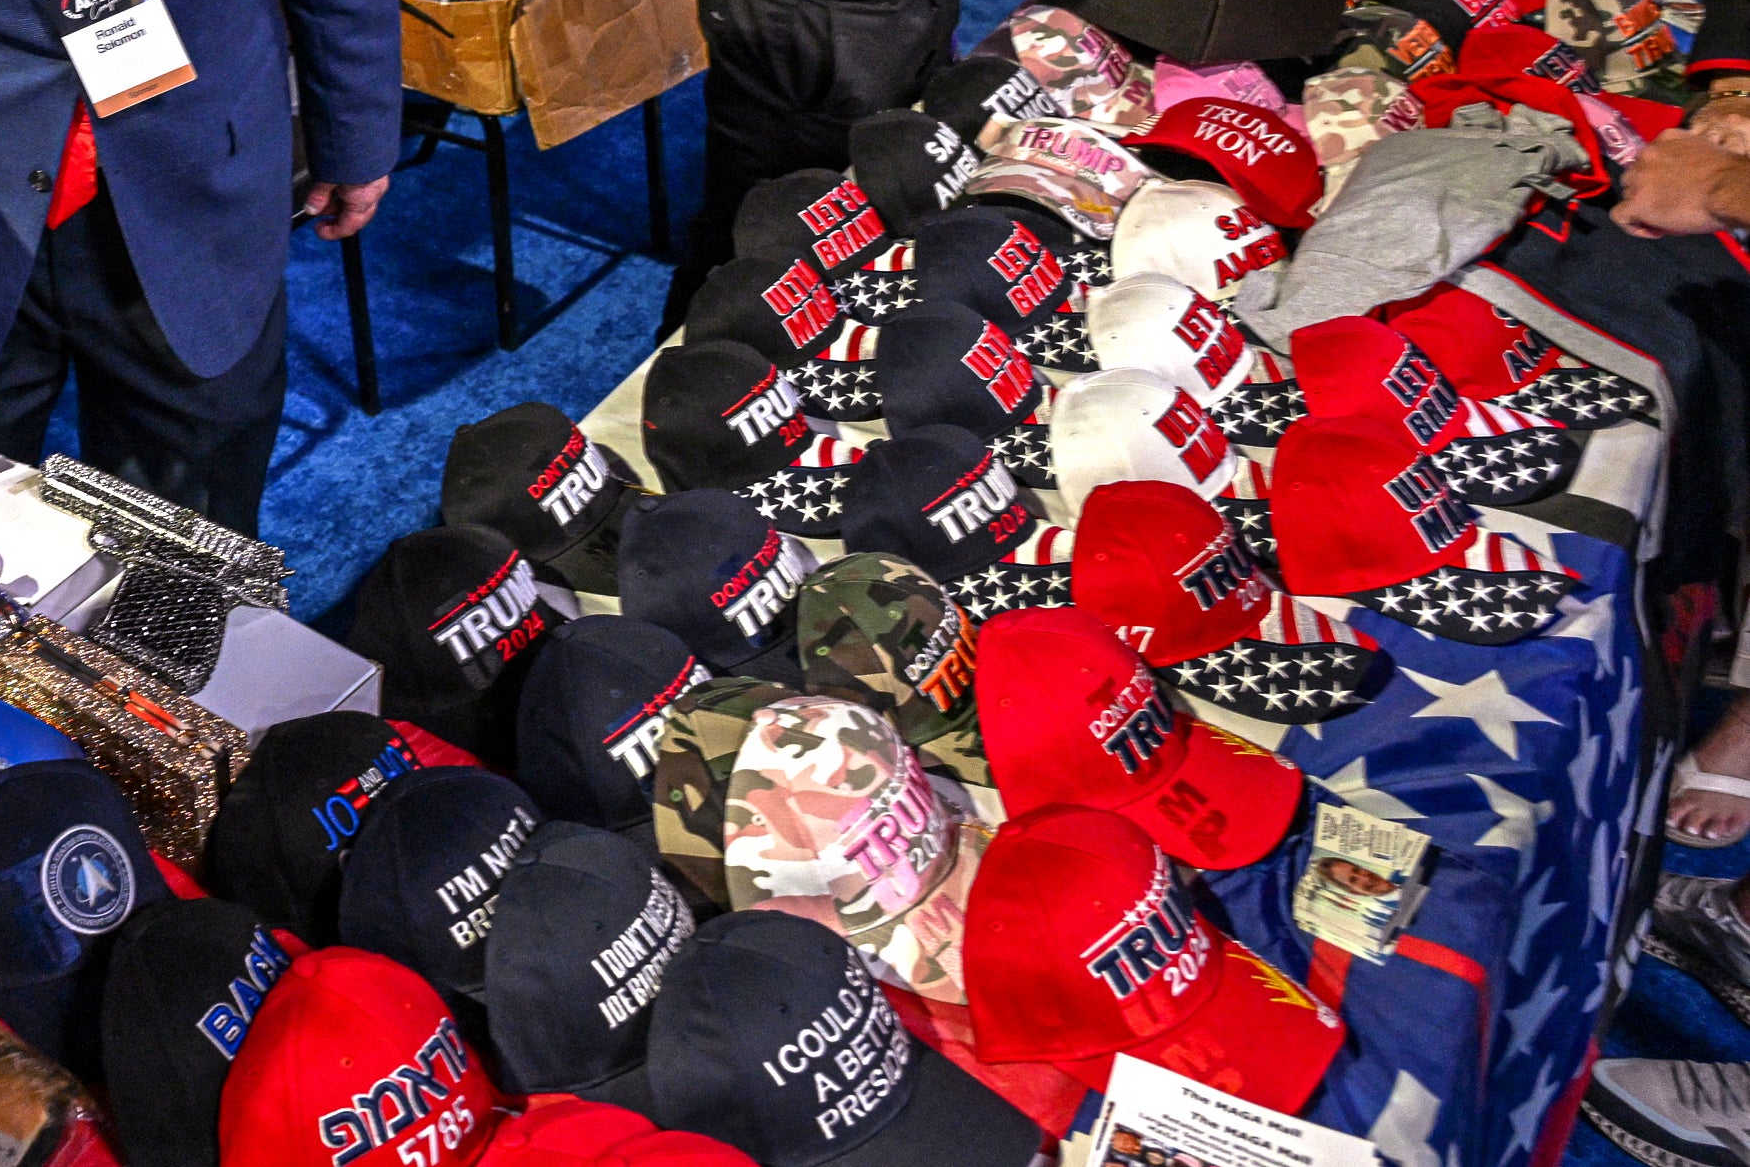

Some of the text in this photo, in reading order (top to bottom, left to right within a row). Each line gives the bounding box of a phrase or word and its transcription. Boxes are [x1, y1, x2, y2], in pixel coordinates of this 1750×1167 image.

[95, 16, 137, 41] Ronald
[1017, 125, 1125, 176] TRUMP
[1192, 120, 1268, 167] WON
[1196, 103, 1297, 156] TRUMP
[812, 206, 887, 270] BRAN
[726, 375, 800, 447] TRUM
[527, 454, 570, 500] DON'T
[538, 437, 610, 526] TRUM
[926, 456, 1018, 545] TRUM
[710, 559, 760, 609] DON'T
[723, 534, 810, 638] TRUM
[1179, 532, 1258, 612] TRU
[433, 558, 540, 664] TRUM
[496, 609, 547, 663] 2024
[916, 604, 979, 713] TRU
[1088, 686, 1138, 739] DON'T
[1101, 684, 1175, 774] TRU
[436, 864, 491, 915] I'M
[590, 917, 658, 988] I DON'T
[1088, 879, 1198, 1001] TRUM
[598, 986, 639, 1029] JOE
[763, 988, 864, 1087] I COULD
[813, 1072, 842, 1104] A
[834, 987, 895, 1081] BETT
[816, 1011, 911, 1140] PRESID
[396, 1094, 475, 1167] 5785
[1181, 1086, 1304, 1139] The MAGA Mall
[1190, 1110, 1219, 1131] The
[1224, 1123, 1274, 1150] MAGA
[1276, 1144, 1314, 1166] Mall
